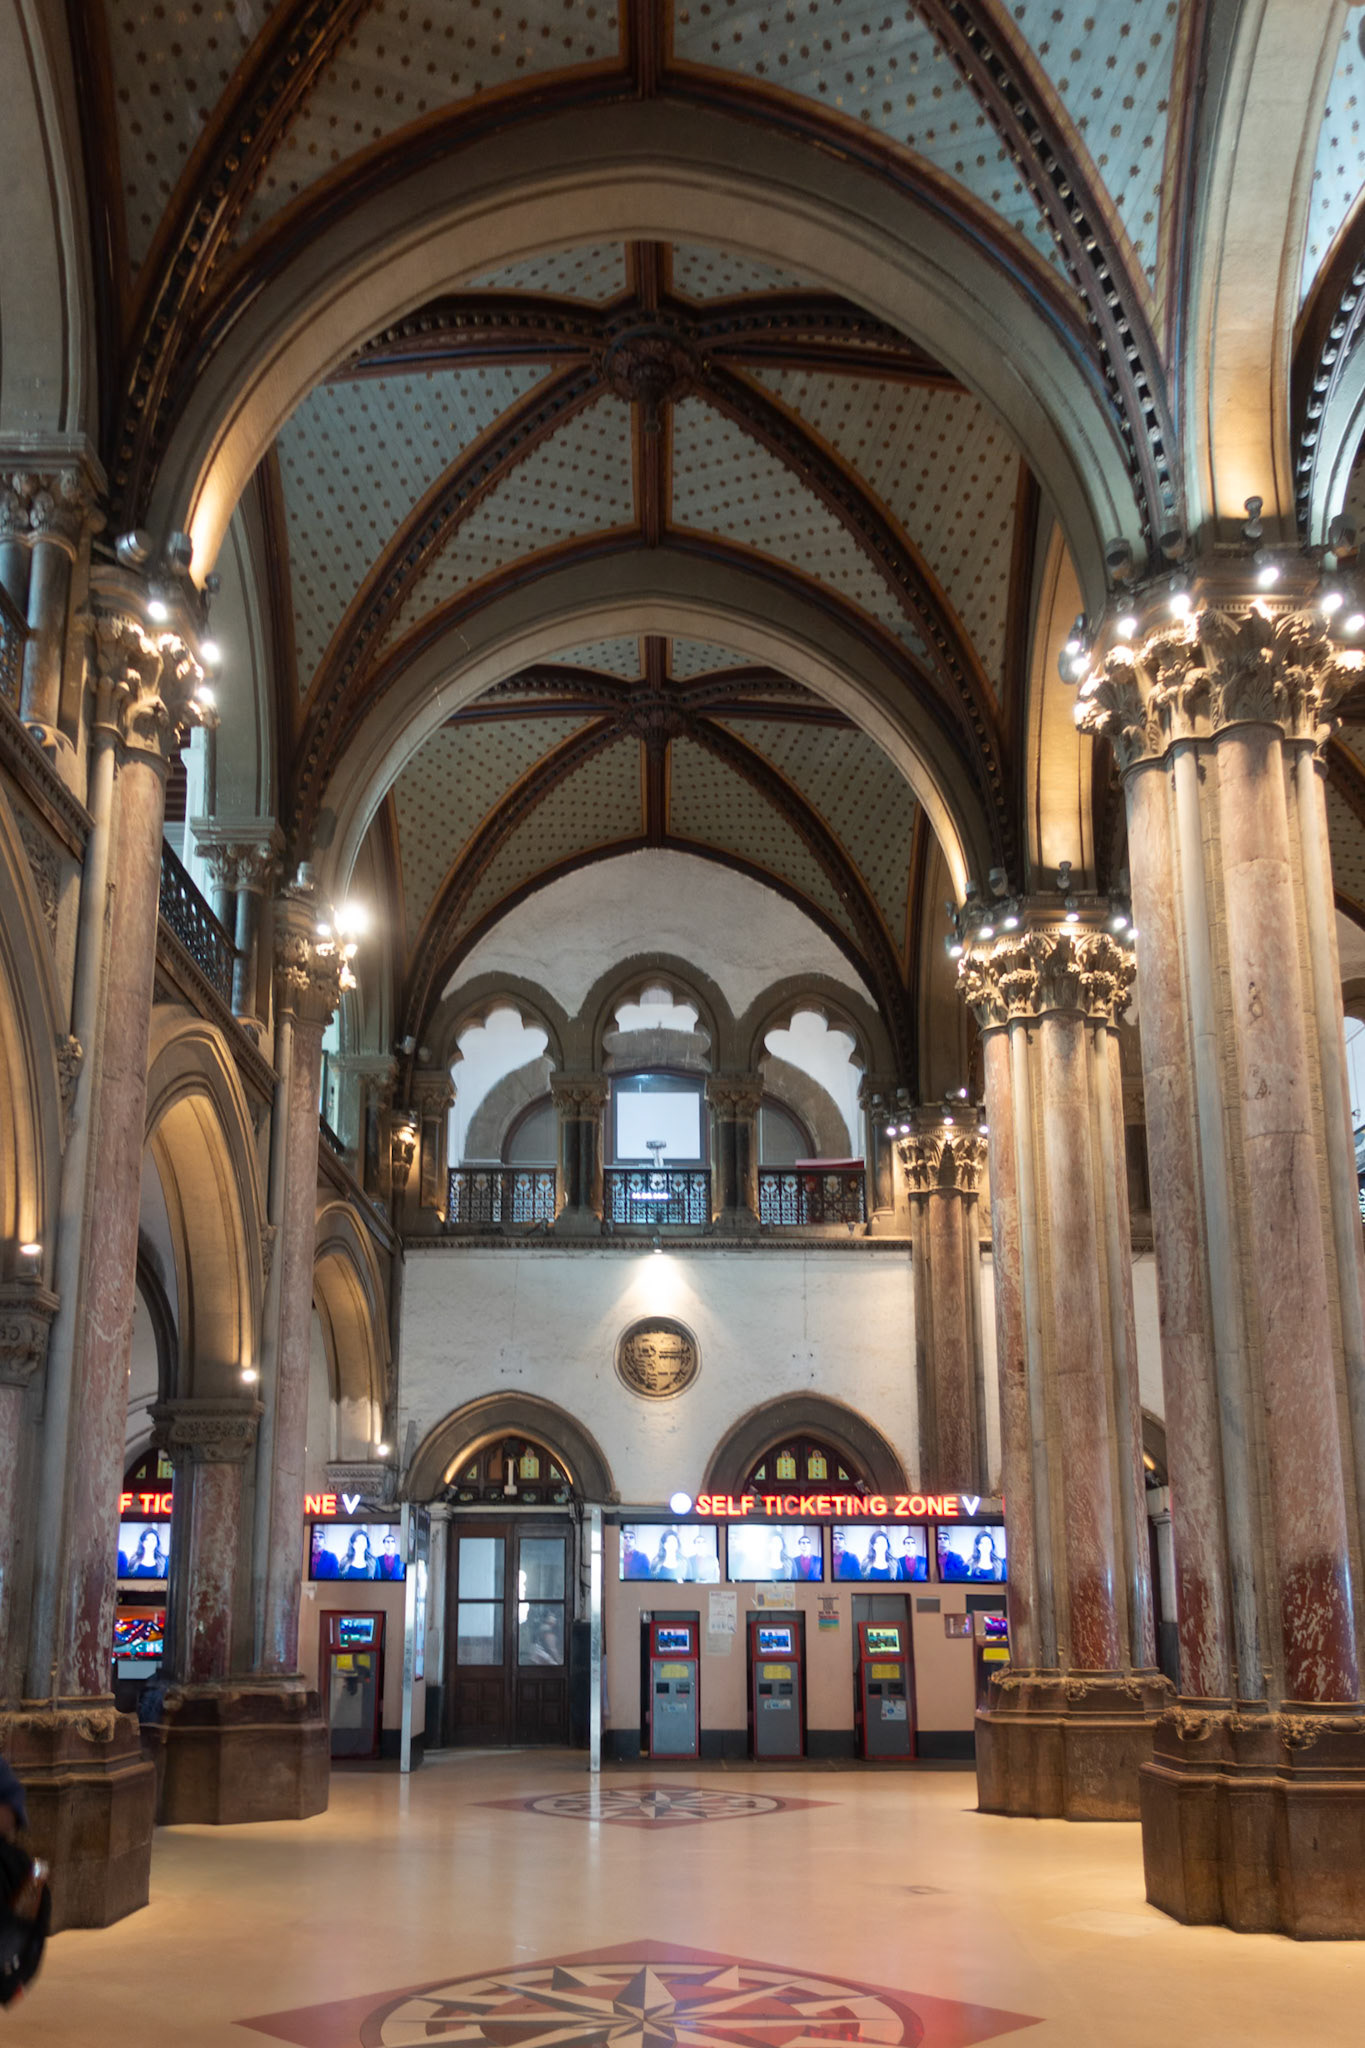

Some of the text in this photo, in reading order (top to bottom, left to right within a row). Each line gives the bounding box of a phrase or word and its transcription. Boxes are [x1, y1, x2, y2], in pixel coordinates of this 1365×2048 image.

[139, 1492, 173, 1514] TIC
[305, 1493, 337, 1516] NE
[696, 1494, 755, 1516] SELF
[761, 1494, 888, 1517] TICKETING
[894, 1494, 959, 1517] ZONE
